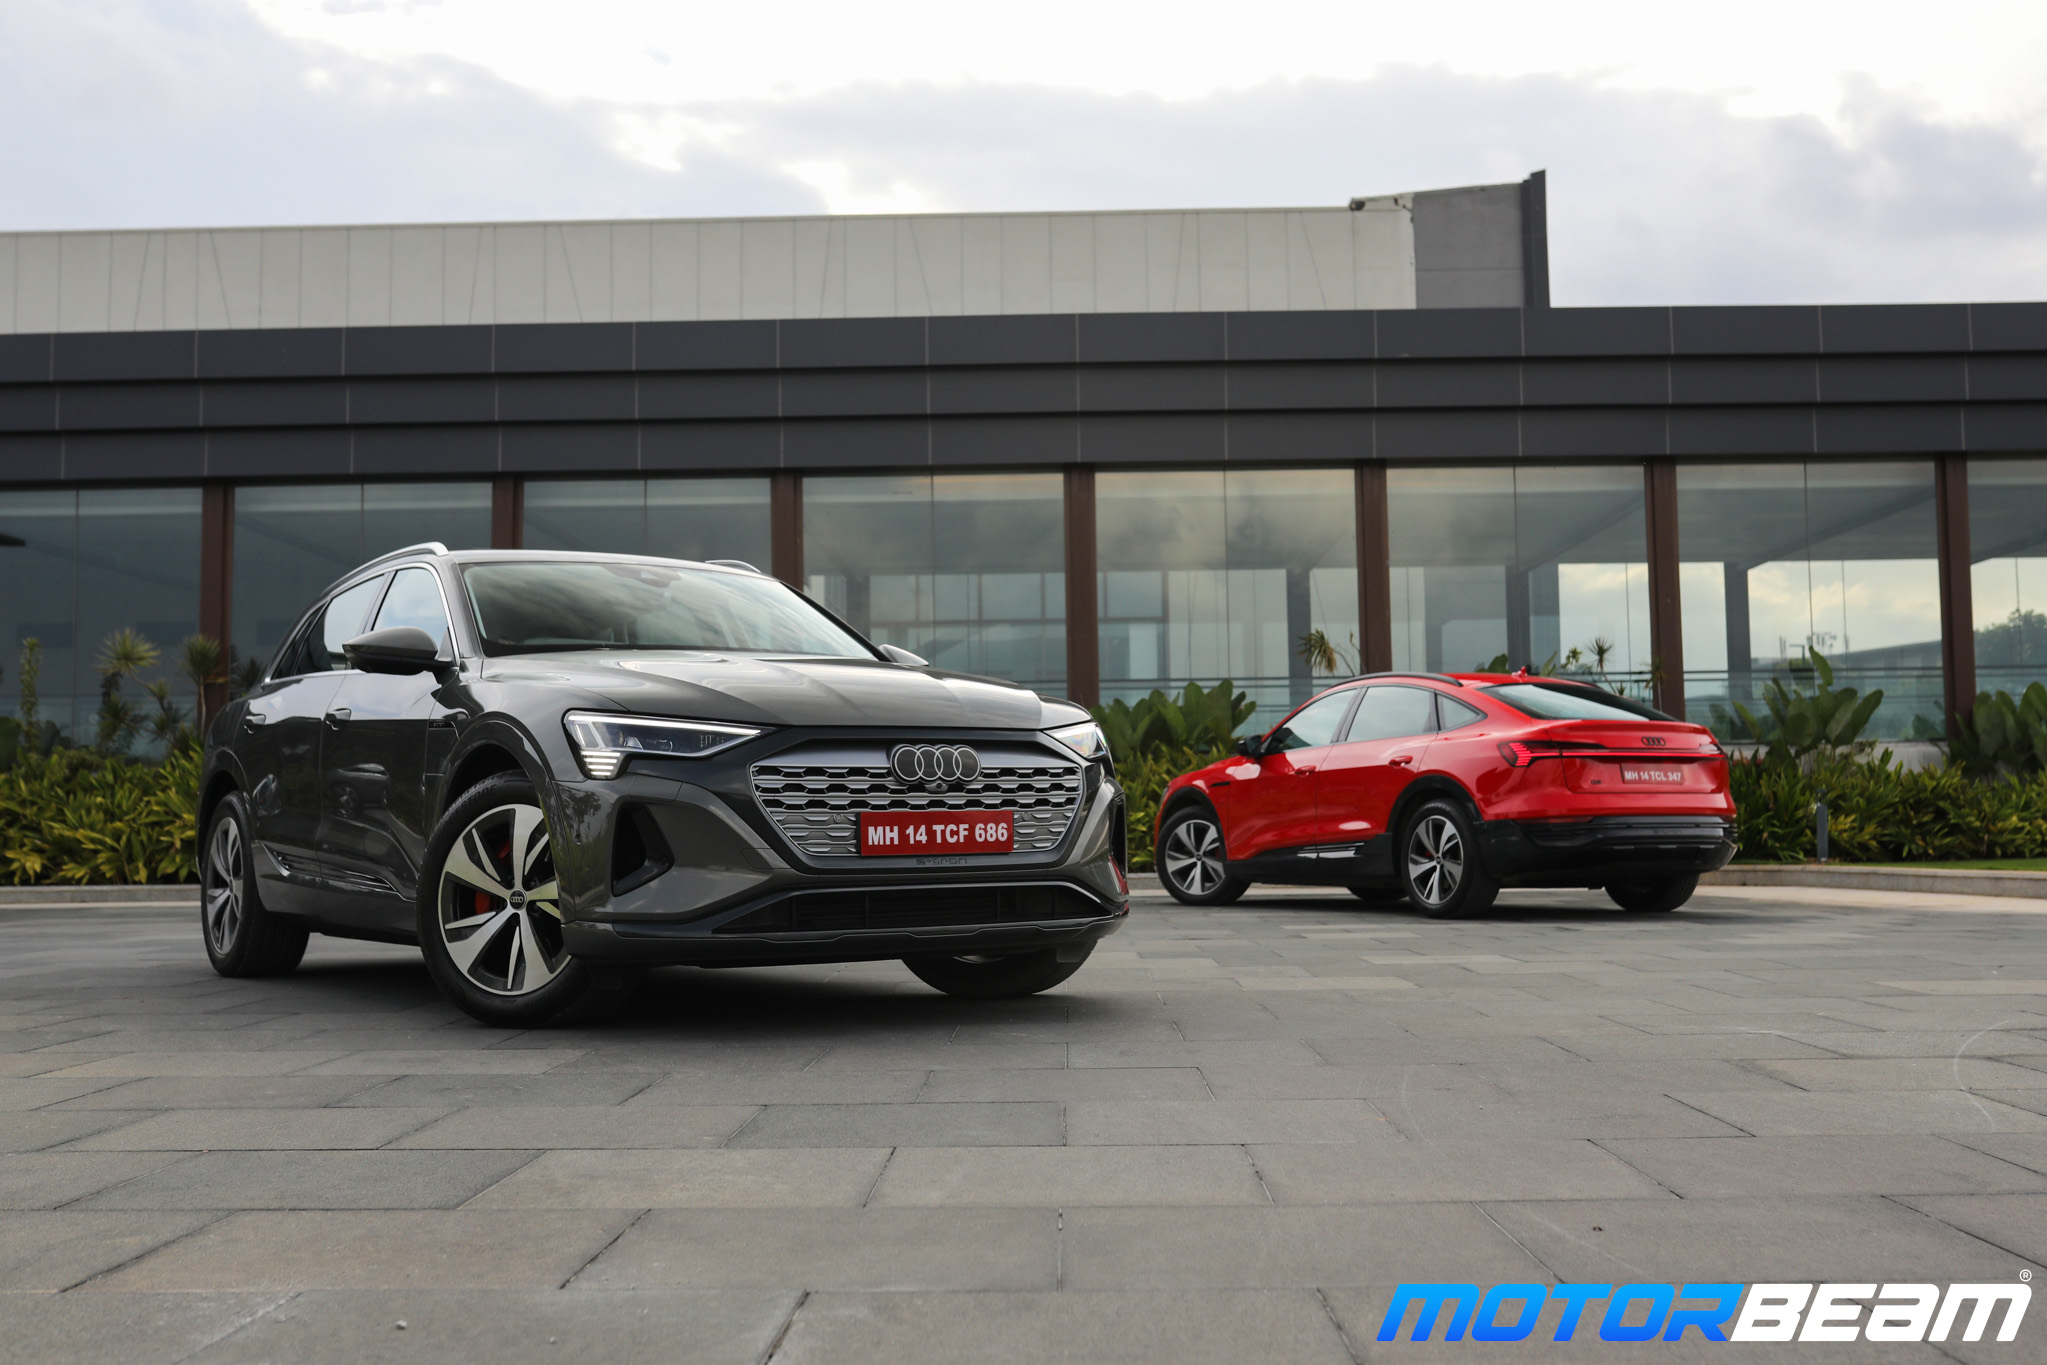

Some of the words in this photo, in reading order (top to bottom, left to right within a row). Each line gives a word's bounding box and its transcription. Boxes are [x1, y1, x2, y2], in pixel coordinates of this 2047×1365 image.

[1624, 770, 1638, 780] MH
[1640, 771, 1649, 780] 14
[867, 825, 899, 845] MH
[905, 825, 928, 844] 14
[932, 823, 970, 844] TCF
[975, 822, 1009, 842] 686
